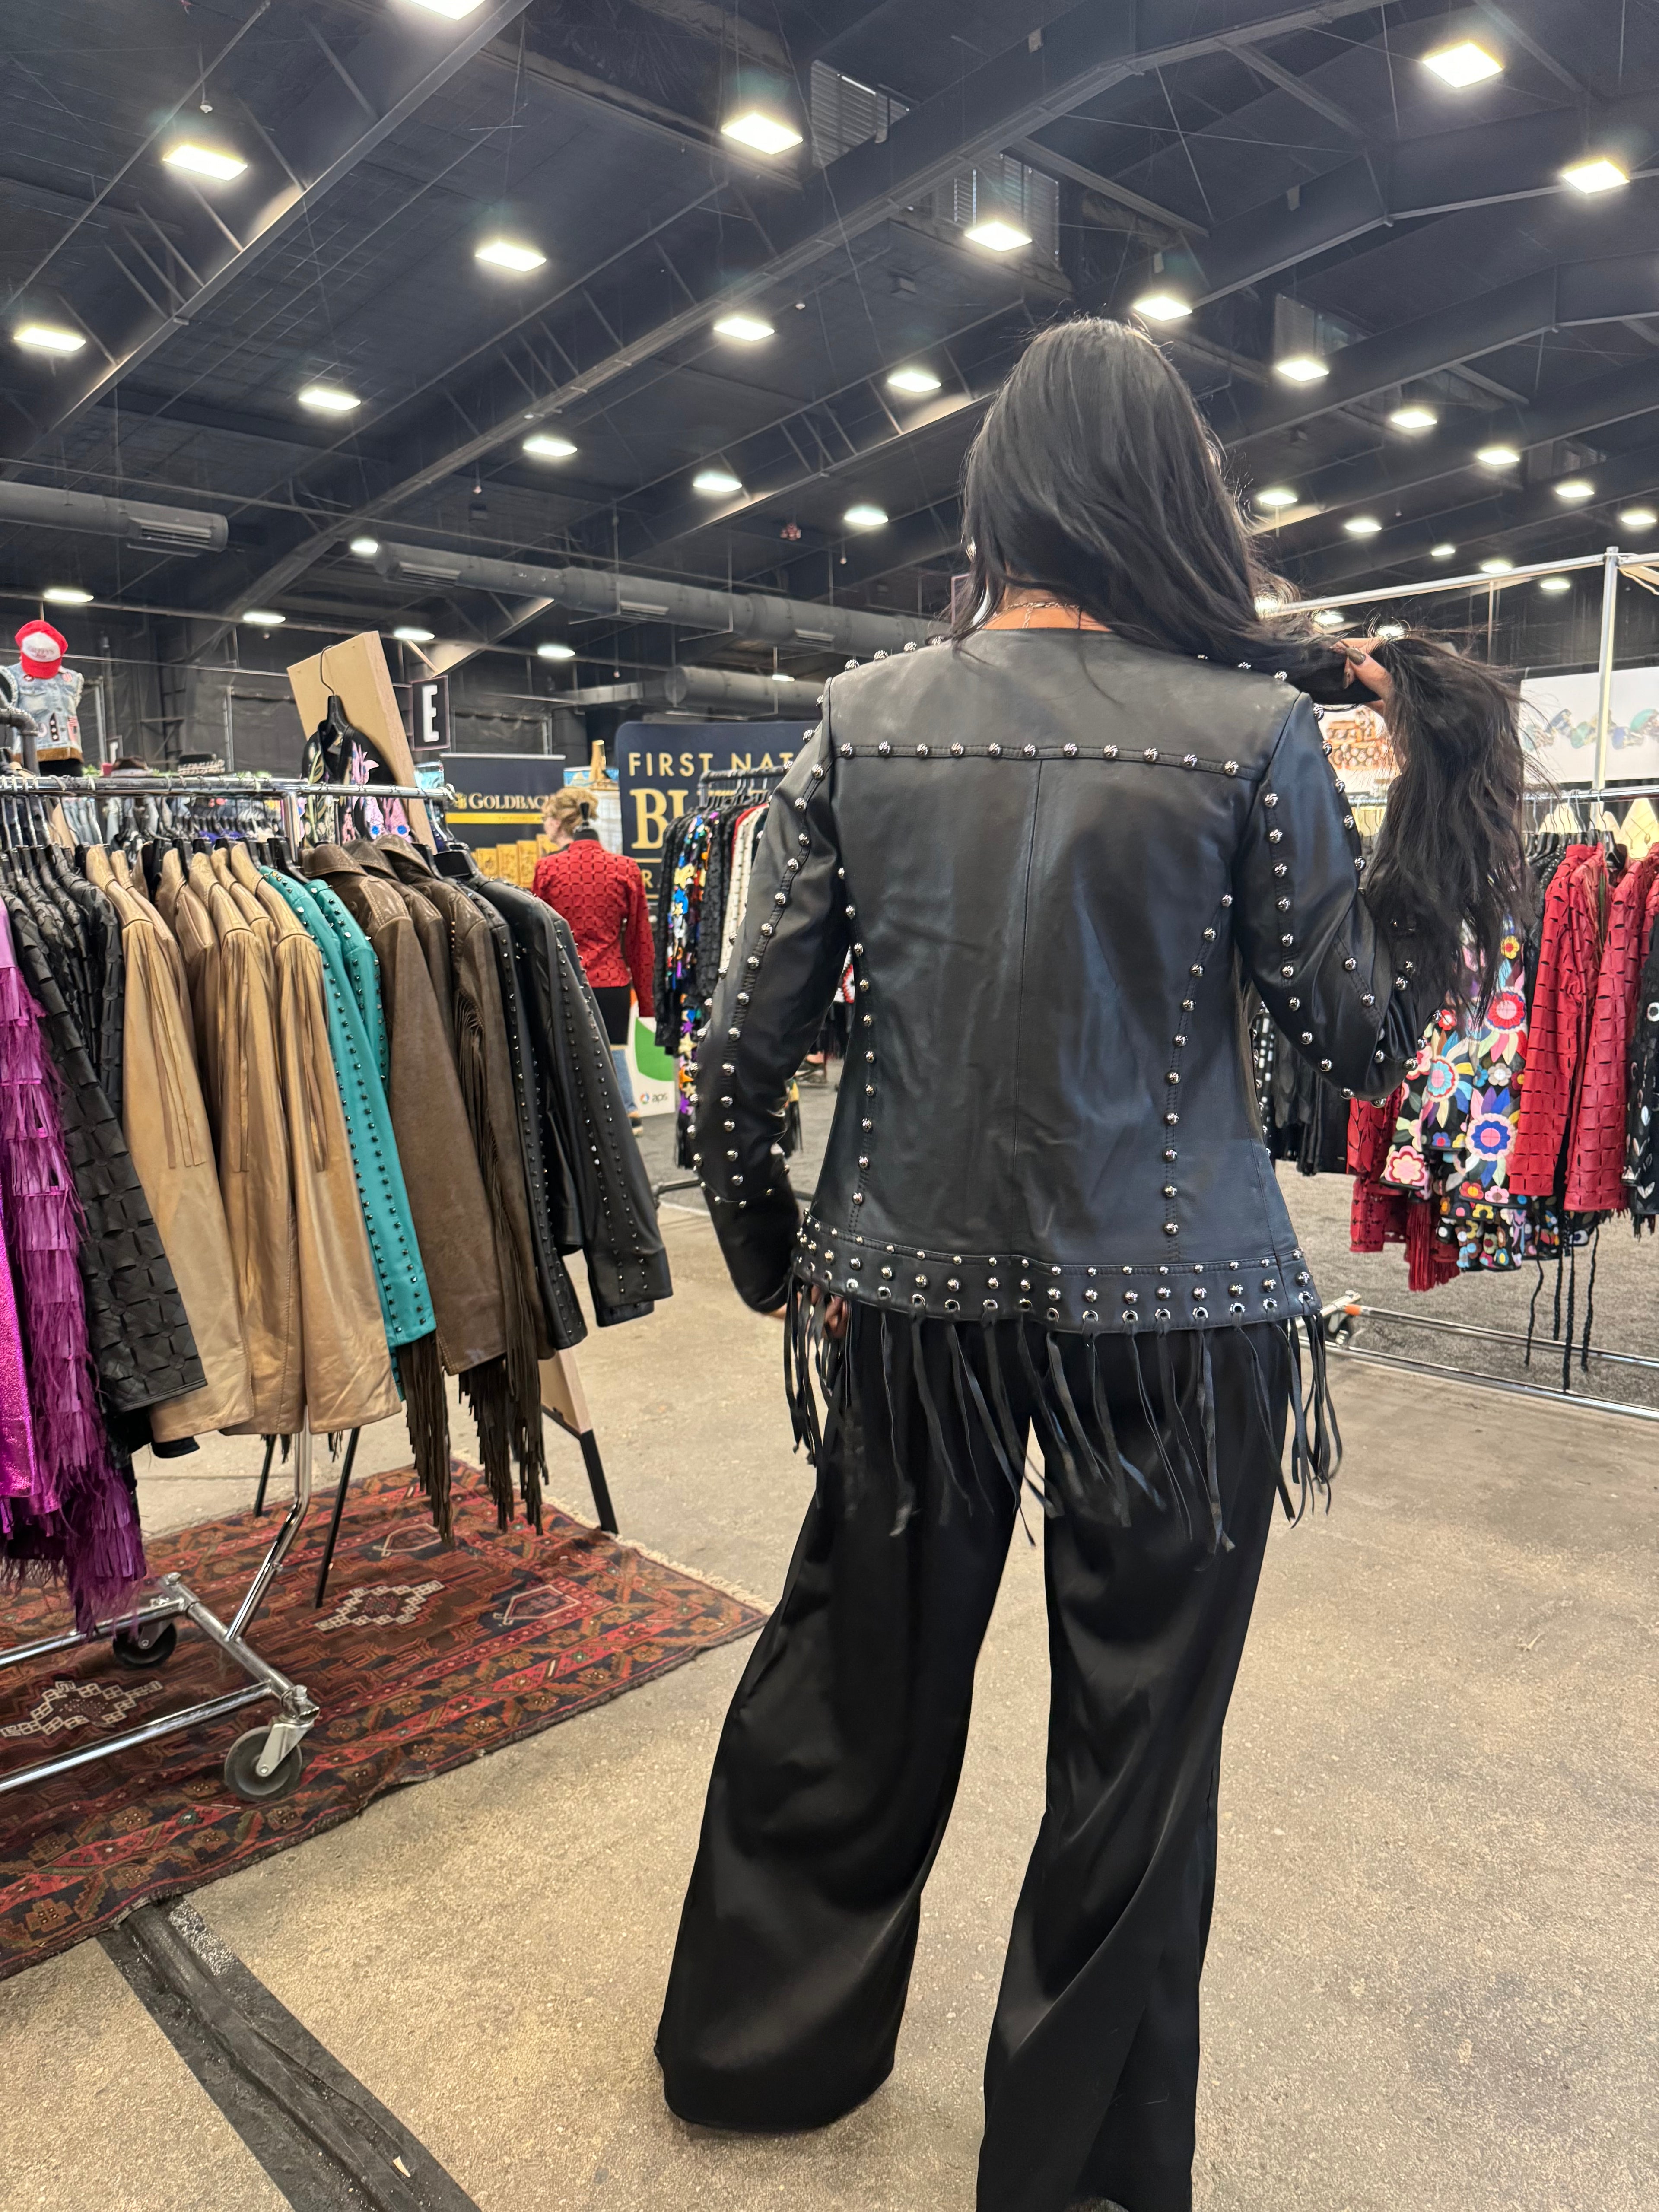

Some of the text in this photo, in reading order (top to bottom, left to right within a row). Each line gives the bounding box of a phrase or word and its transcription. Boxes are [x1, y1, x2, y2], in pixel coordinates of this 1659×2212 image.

[422, 685, 439, 742] E
[629, 753, 713, 777] FIRST
[468, 792, 550, 809] GOLDBAC
